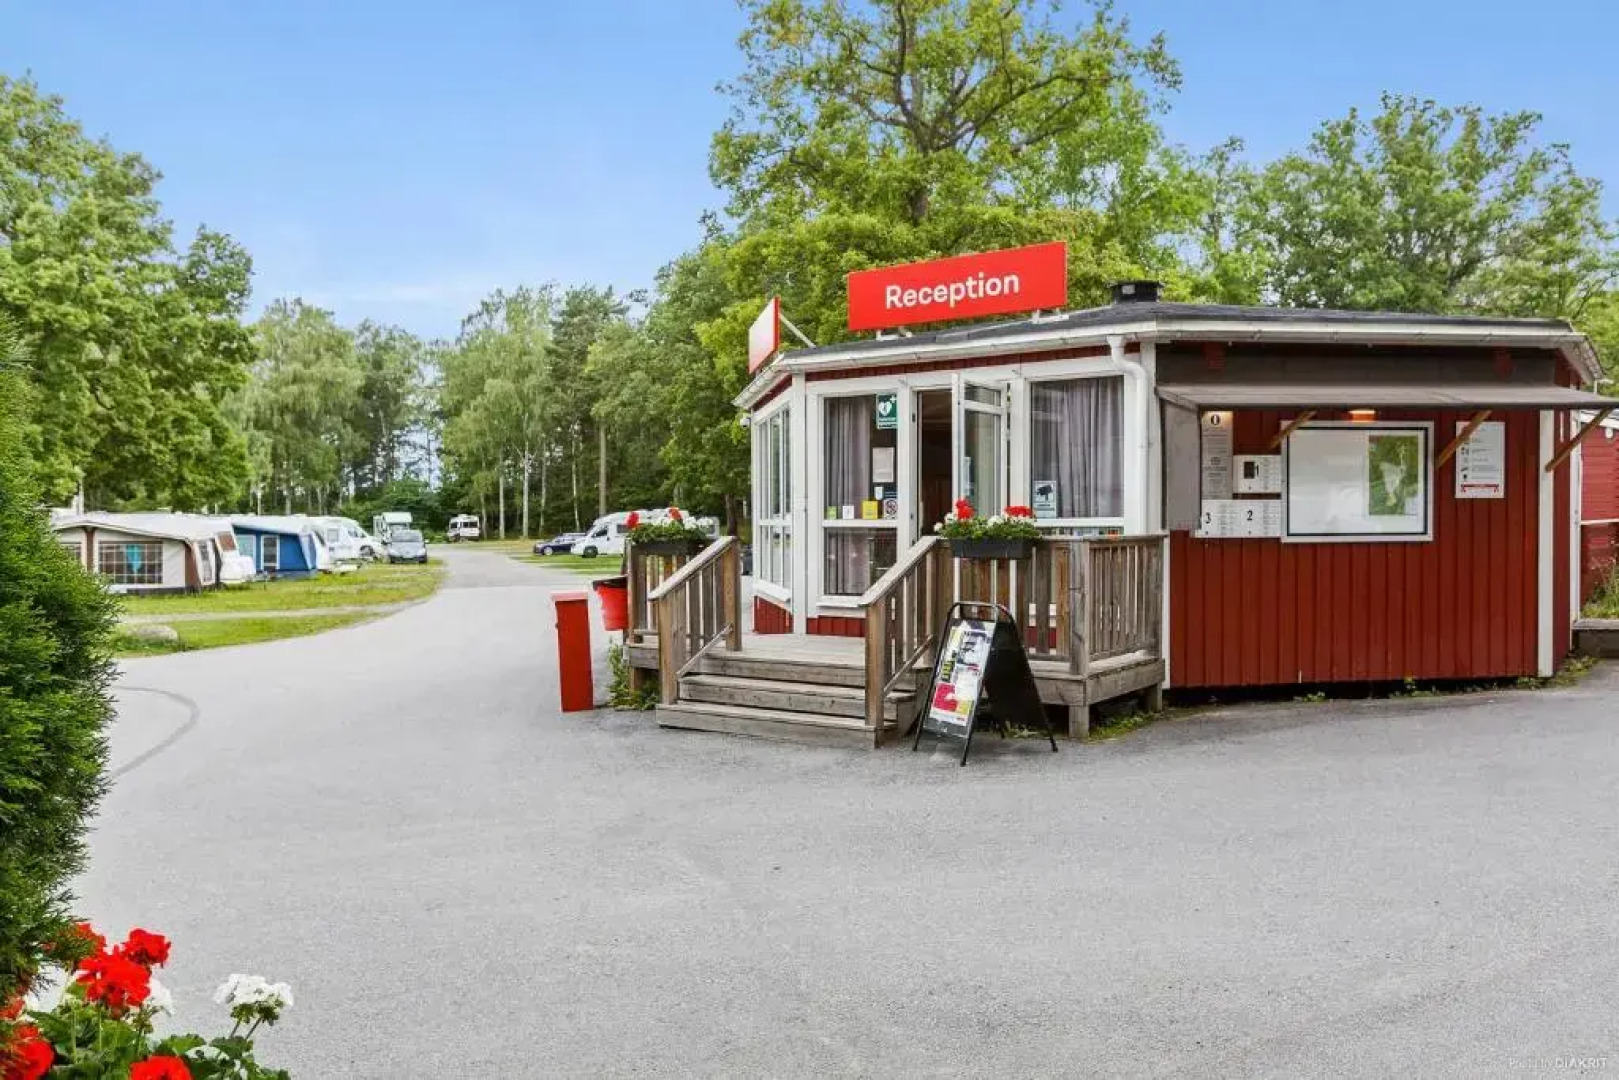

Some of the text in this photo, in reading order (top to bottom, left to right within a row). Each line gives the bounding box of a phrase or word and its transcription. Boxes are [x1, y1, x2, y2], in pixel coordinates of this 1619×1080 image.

[886, 271, 1019, 309] Reception
[1205, 511, 1212, 524] 3
[1246, 509, 1253, 521] 2
